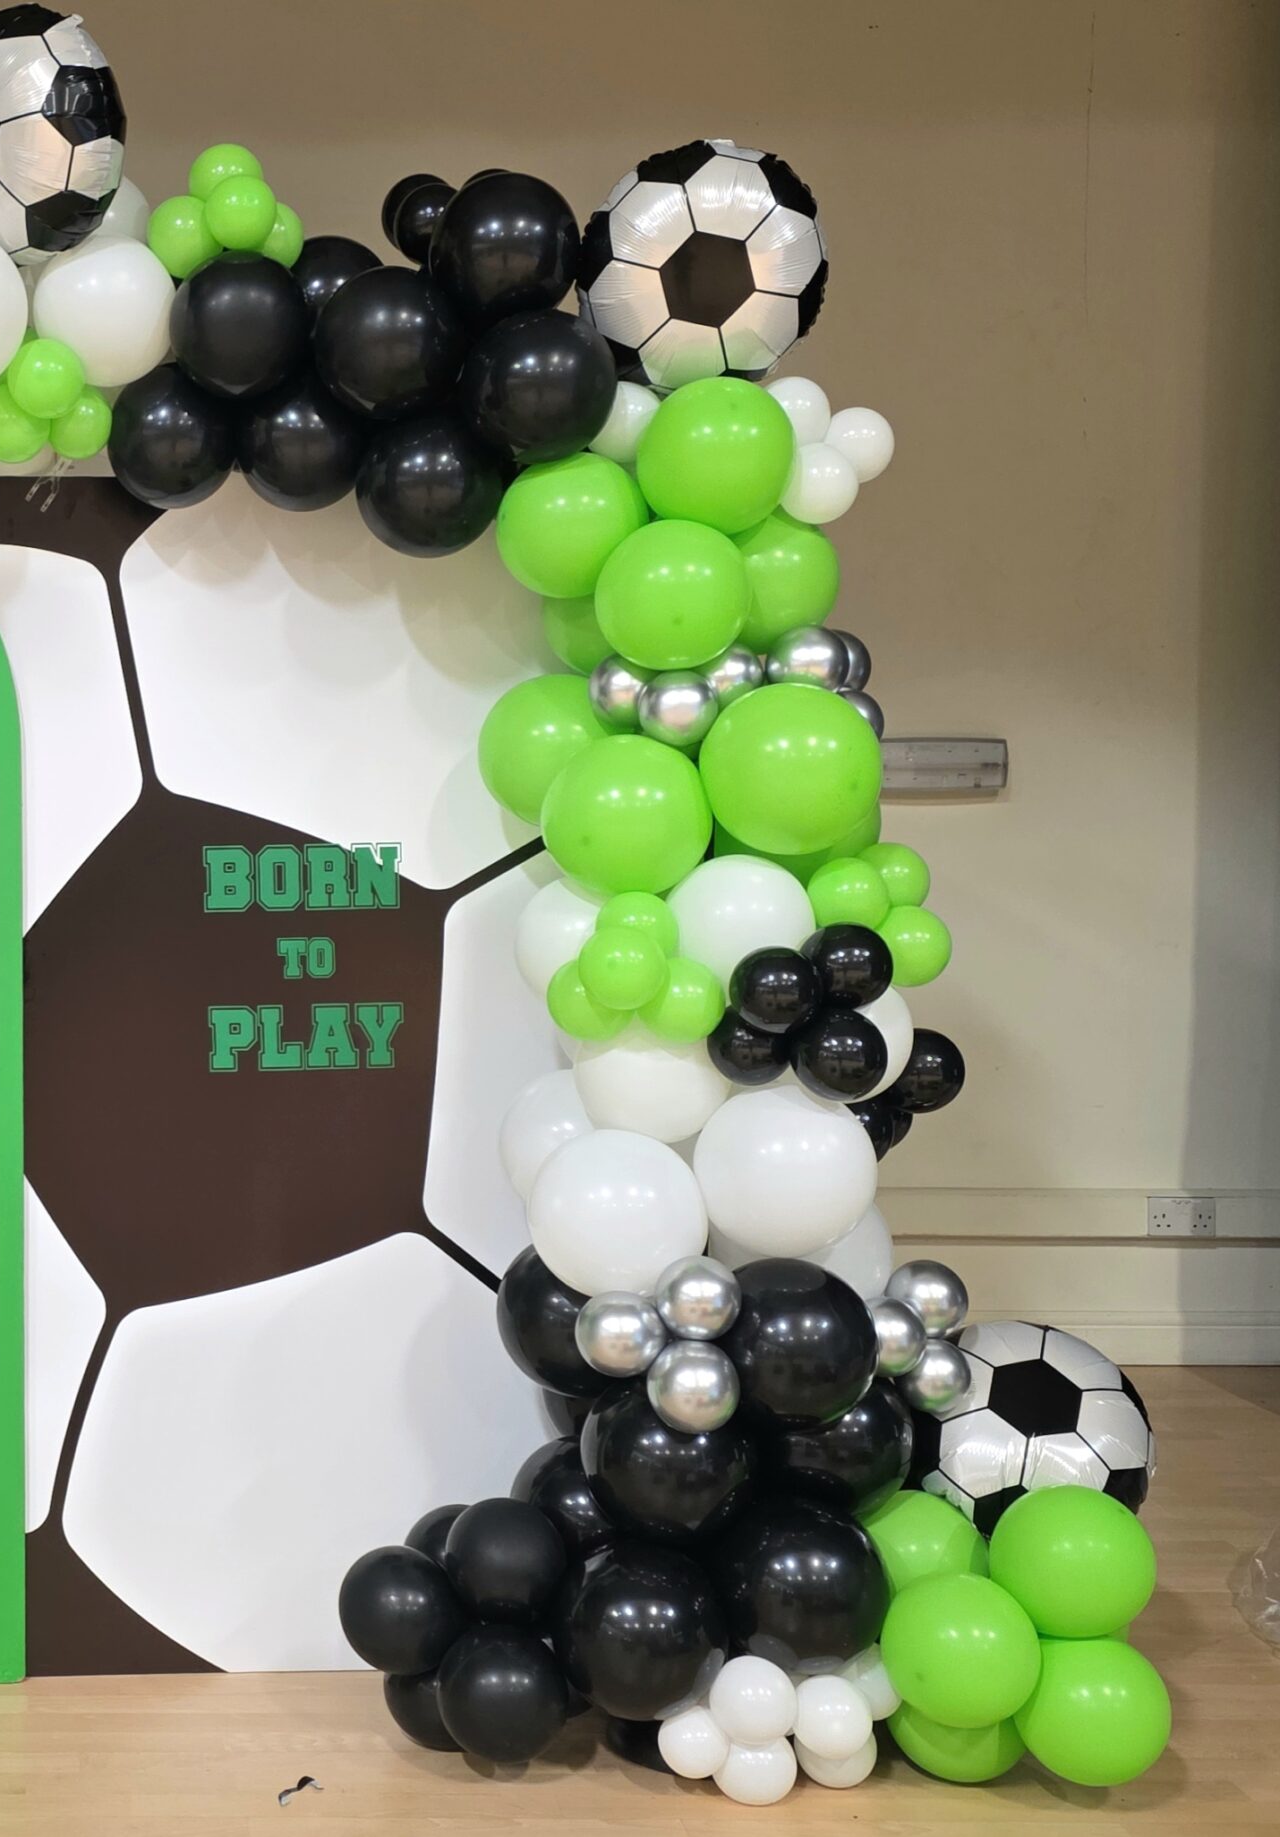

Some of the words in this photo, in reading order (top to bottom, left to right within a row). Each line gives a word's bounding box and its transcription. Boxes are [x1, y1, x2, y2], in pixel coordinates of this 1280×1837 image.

[203, 842, 402, 912] BORN
[276, 937, 336, 979] TO
[208, 1002, 404, 1072] PLAY
